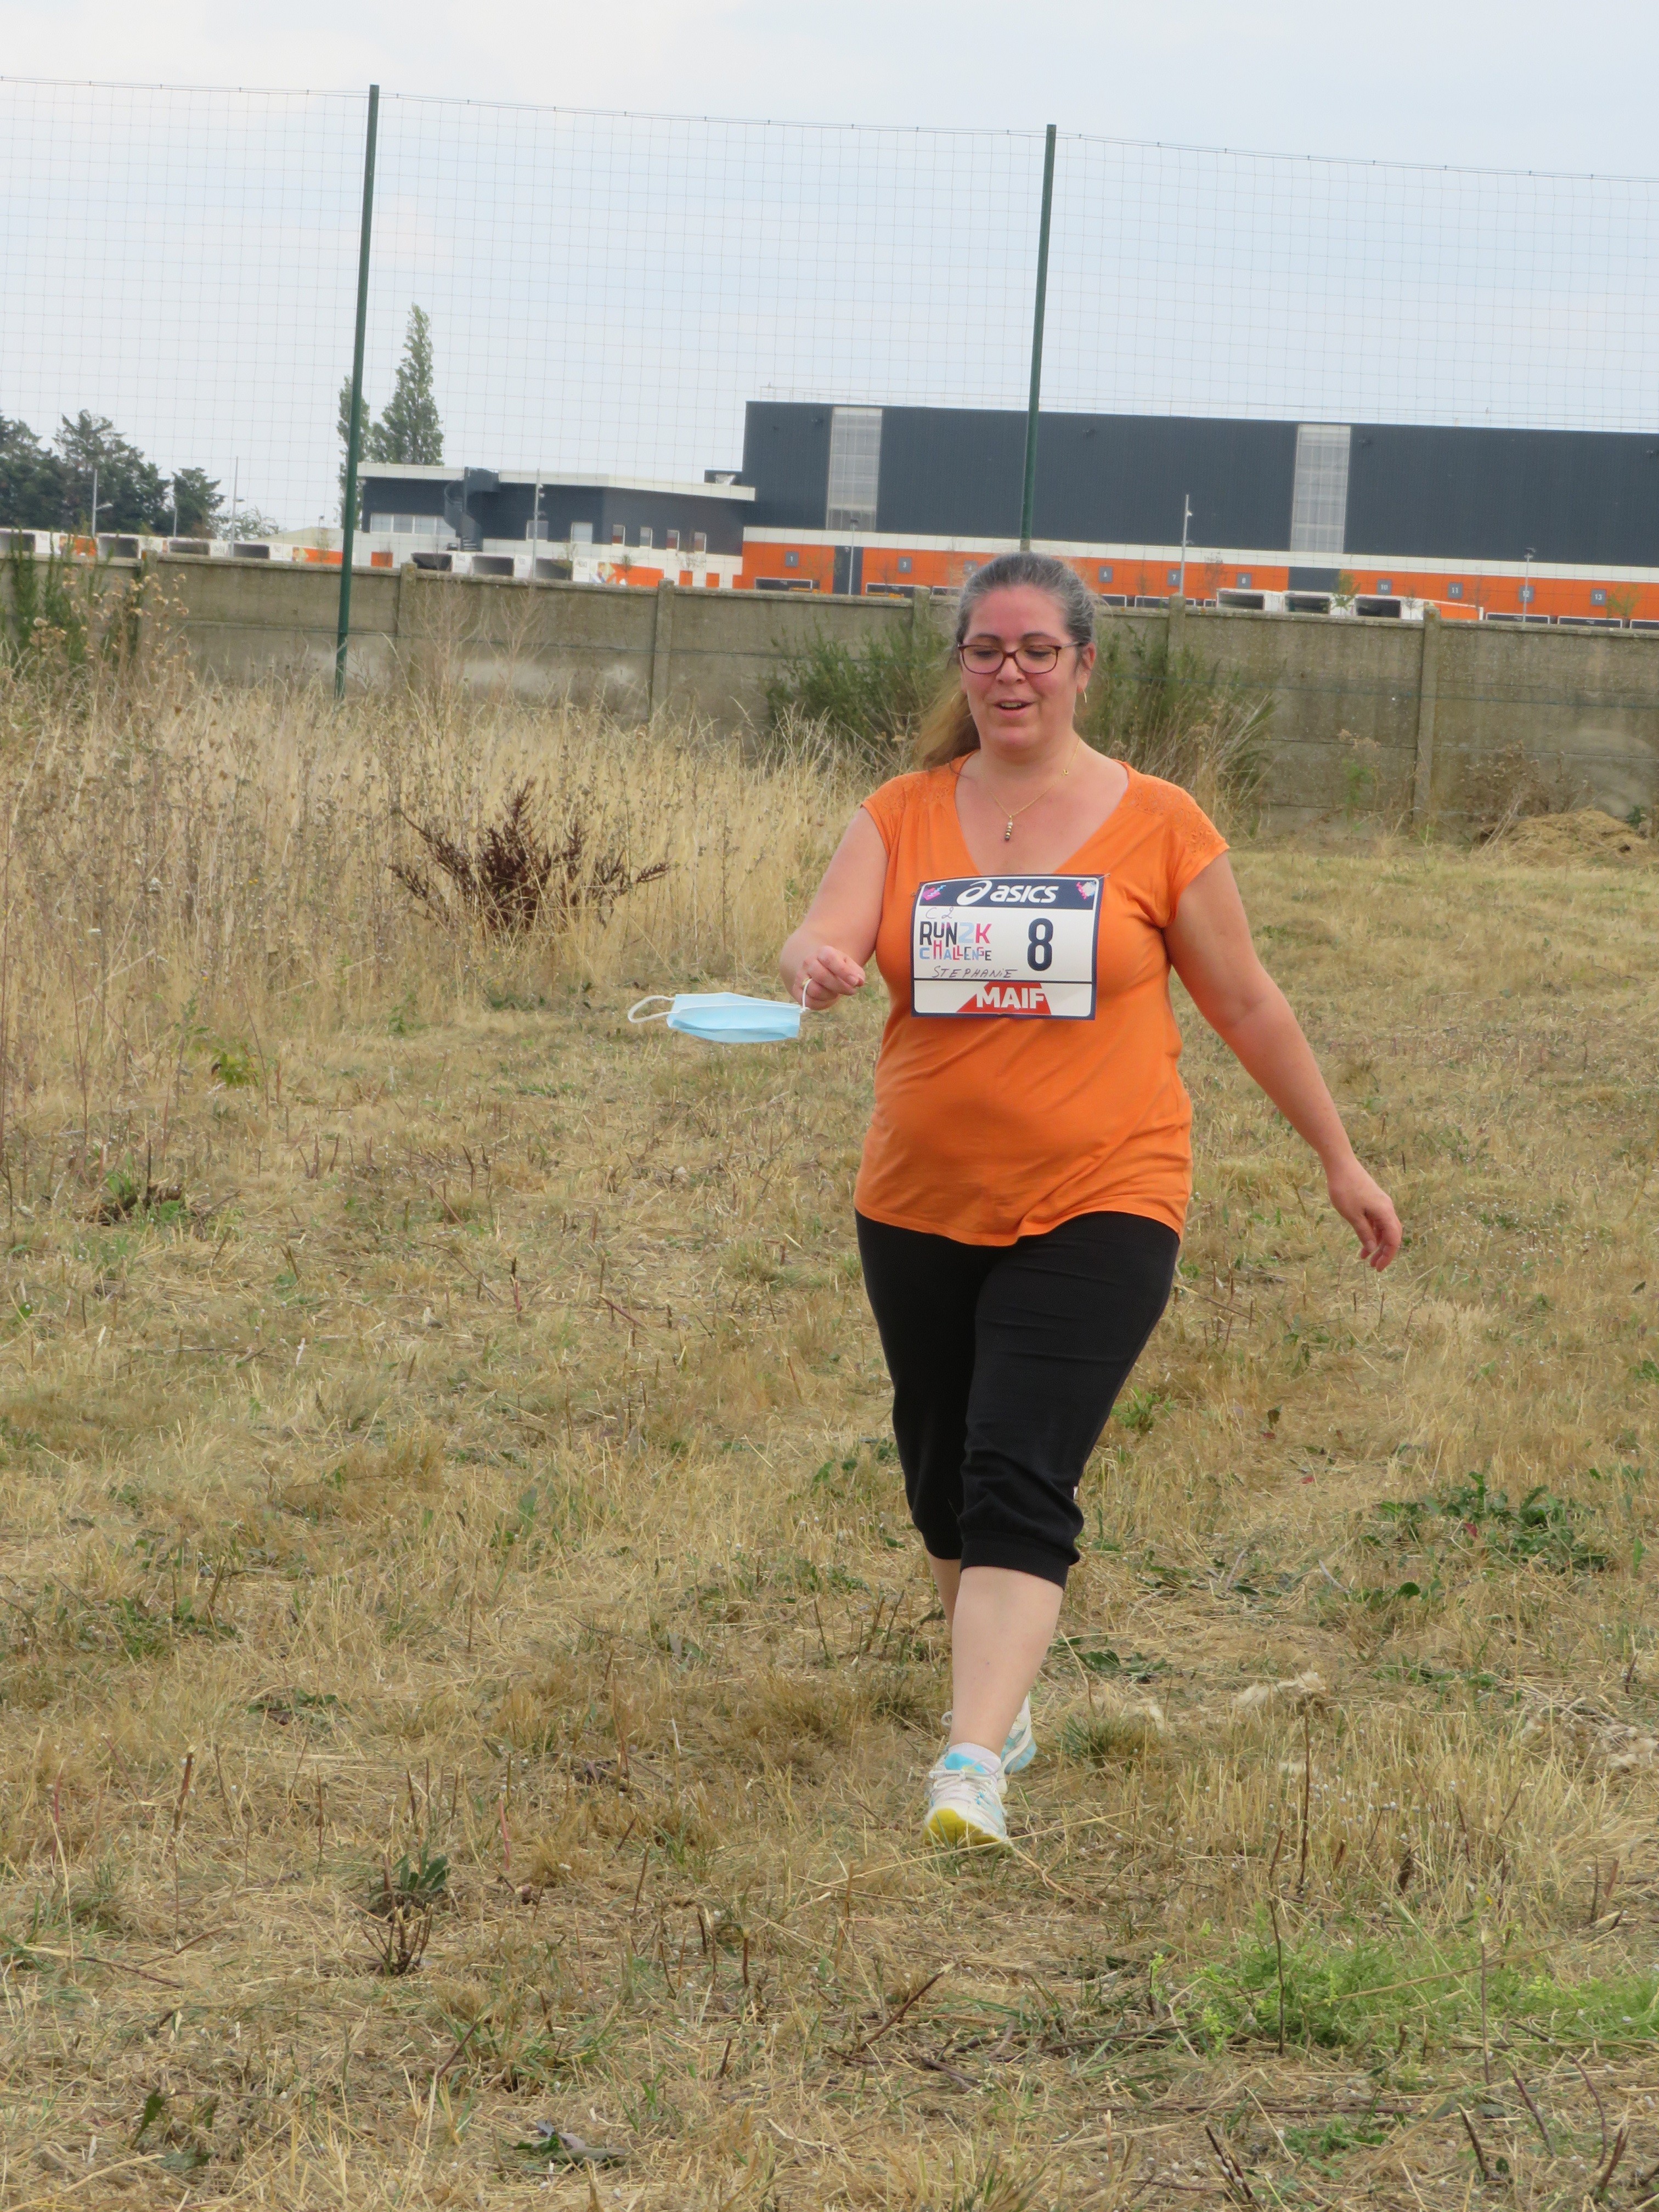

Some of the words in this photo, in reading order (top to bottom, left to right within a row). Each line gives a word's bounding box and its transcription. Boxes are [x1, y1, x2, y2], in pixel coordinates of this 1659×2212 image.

[990, 884, 1059, 903] asics
[919, 921, 992, 948] RUN2K
[1027, 918, 1054, 972] 8
[919, 940, 992, 961] CHALLENGE
[975, 986, 1045, 1009] MAIF
